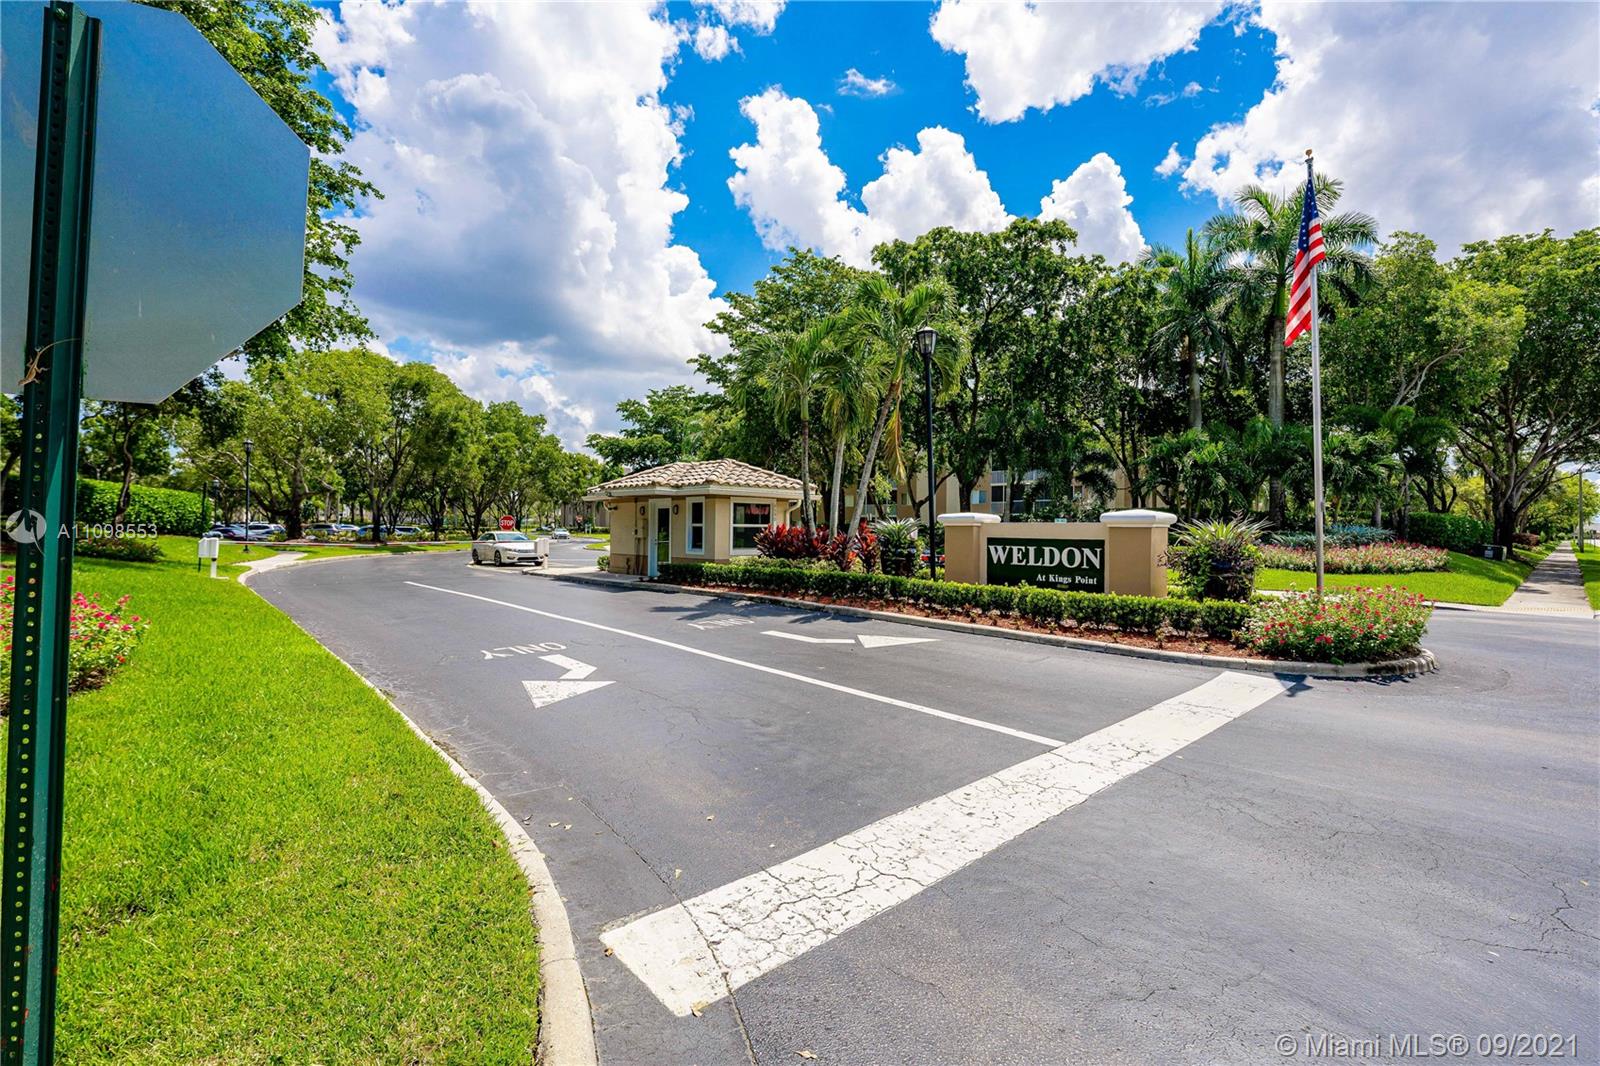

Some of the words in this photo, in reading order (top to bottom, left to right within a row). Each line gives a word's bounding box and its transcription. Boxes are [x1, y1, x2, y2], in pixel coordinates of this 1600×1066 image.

[988, 544, 1102, 569] WELDON
[1049, 574, 1072, 583] Kings
[1075, 575, 1097, 584] Point
[481, 642, 567, 660] ONLY
